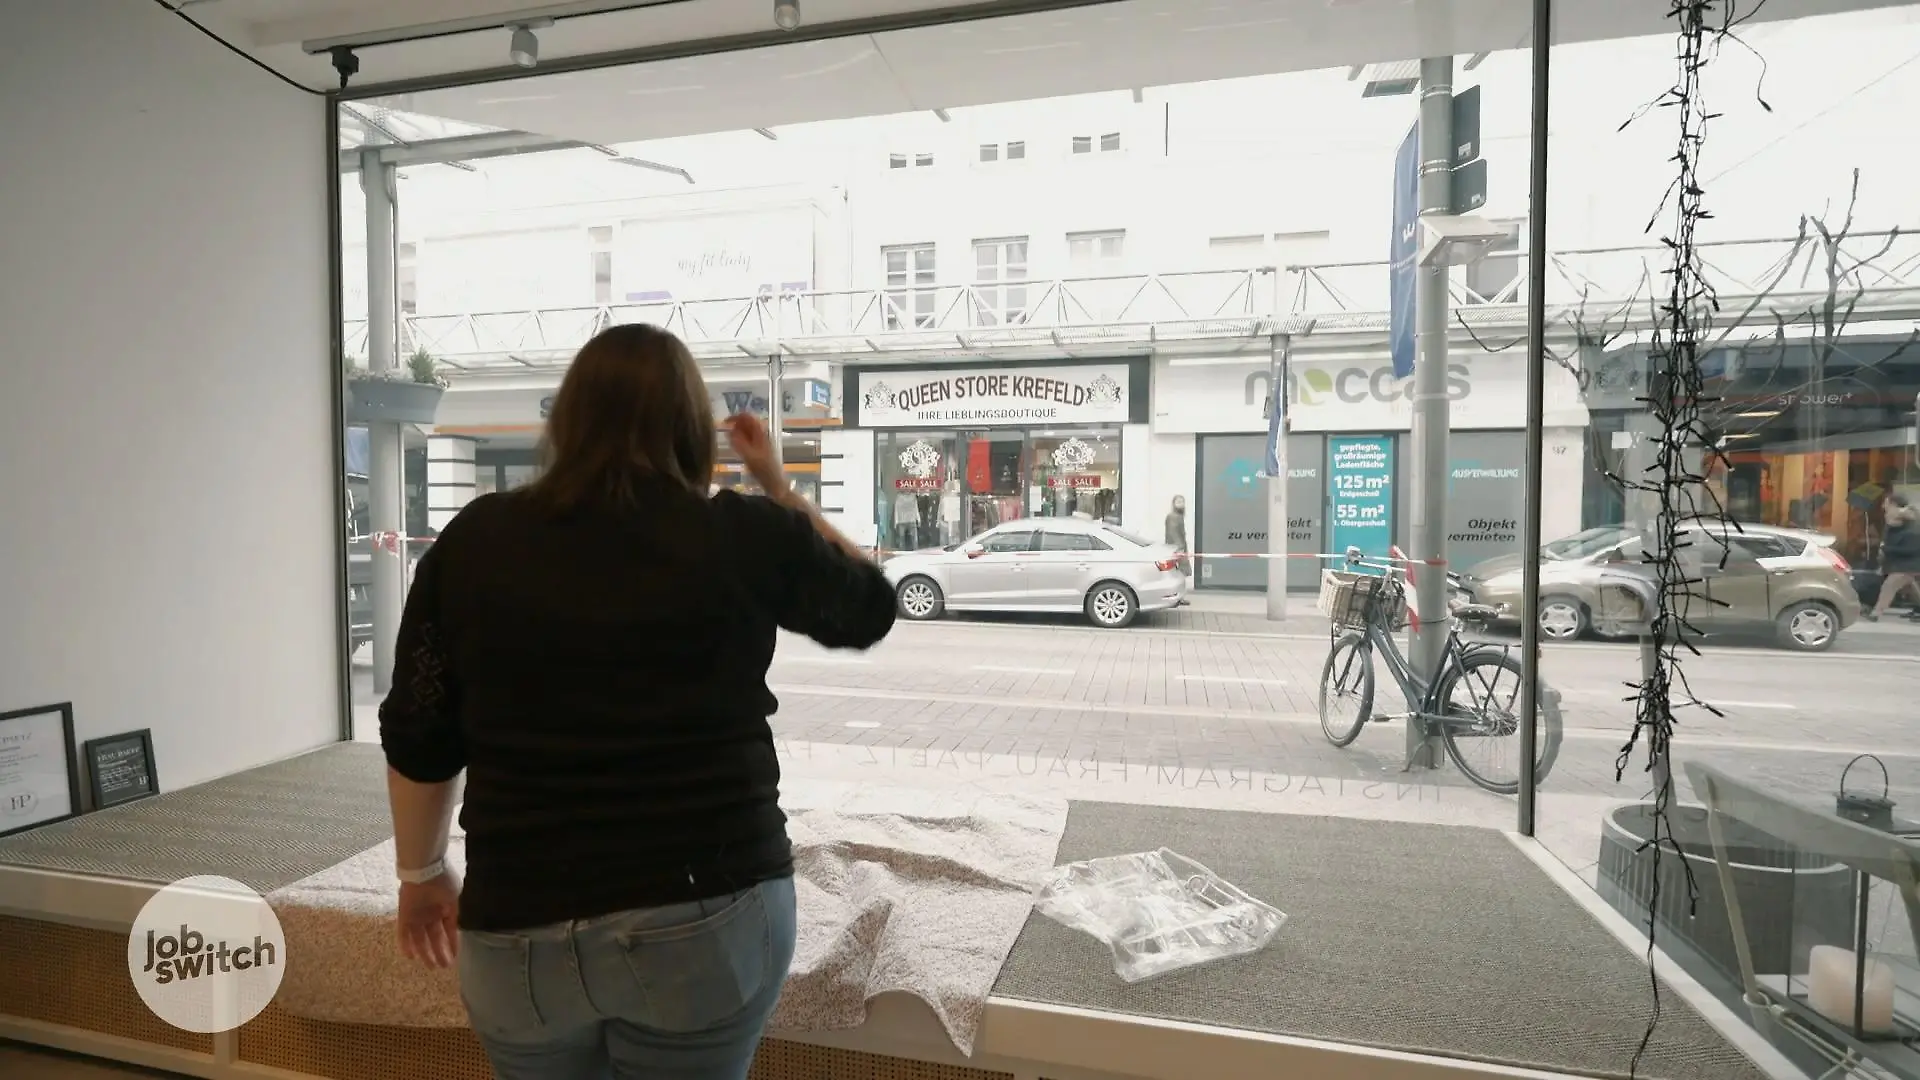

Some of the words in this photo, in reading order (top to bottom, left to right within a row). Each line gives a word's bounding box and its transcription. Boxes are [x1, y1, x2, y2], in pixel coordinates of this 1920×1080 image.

[899, 379, 951, 411] QUEEN
[955, 375, 1009, 398] STORE
[1012, 376, 1085, 407] KREFELD
[918, 410, 942, 420] IHRE
[945, 408, 1057, 420] LIEBLINGSBOUTIQUE
[1336, 460, 1385, 469] Ladenfläche
[920, 479, 937, 488] SALE
[1075, 478, 1094, 487] SALE
[1334, 475, 1364, 489] 125
[1366, 474, 1390, 489] m²
[1337, 504, 1358, 518] 55
[1361, 504, 1385, 518] m²
[1468, 518, 1517, 531] Objekt
[1228, 531, 1242, 540] zu
